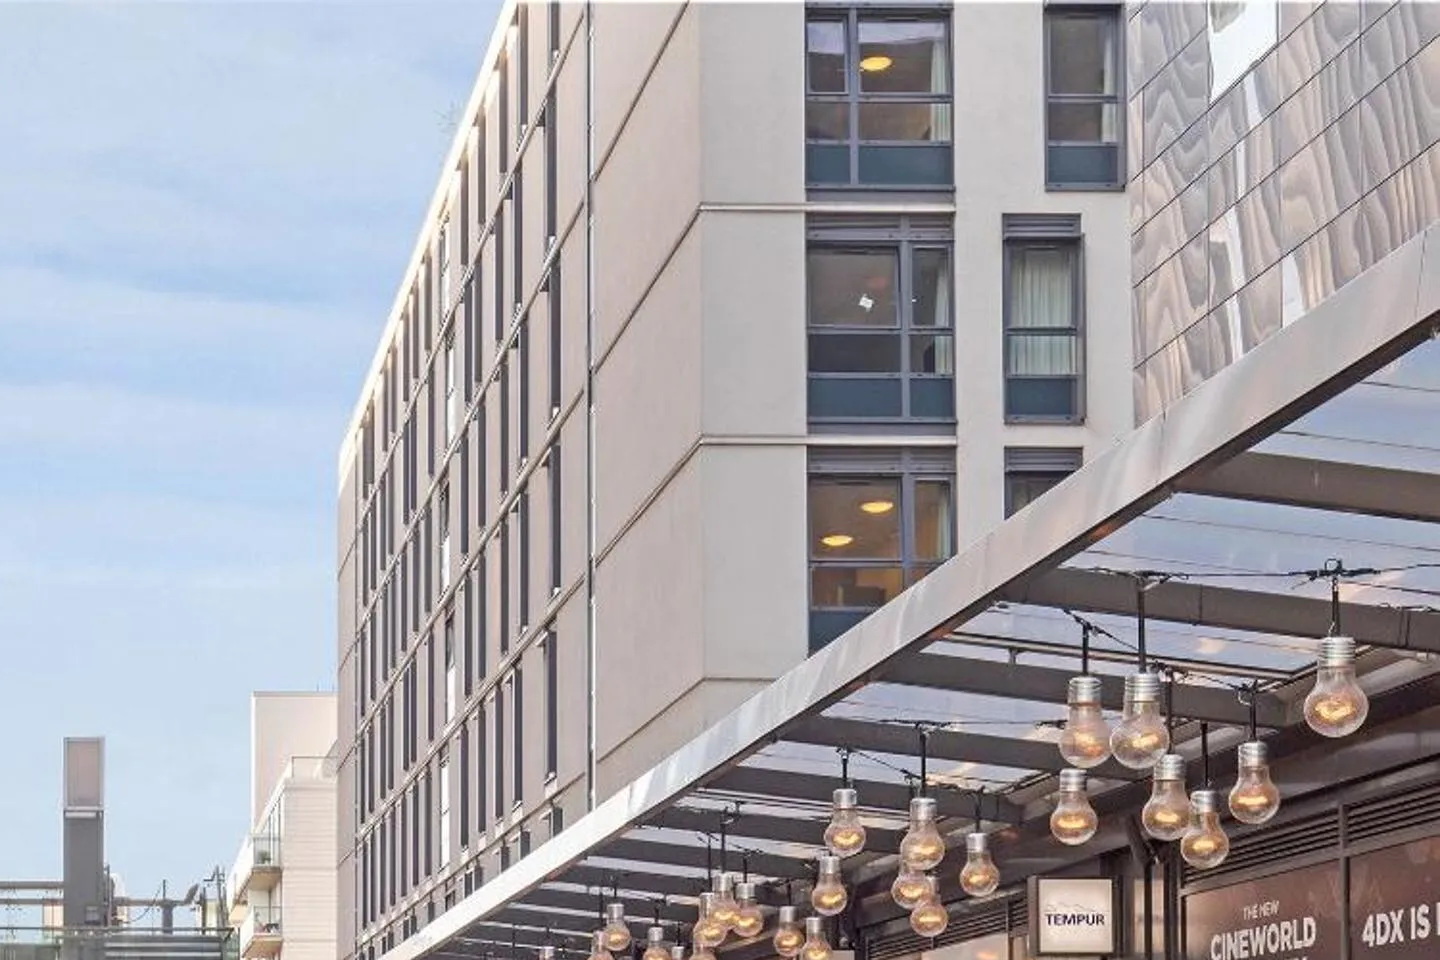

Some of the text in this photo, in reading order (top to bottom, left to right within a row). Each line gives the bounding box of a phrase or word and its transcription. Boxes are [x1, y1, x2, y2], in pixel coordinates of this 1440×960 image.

[1045, 913, 1105, 926] TEMPUR
[1243, 900, 1280, 920] THE NEW
[1362, 908, 1405, 947] 4DX
[1410, 903, 1432, 941] IS
